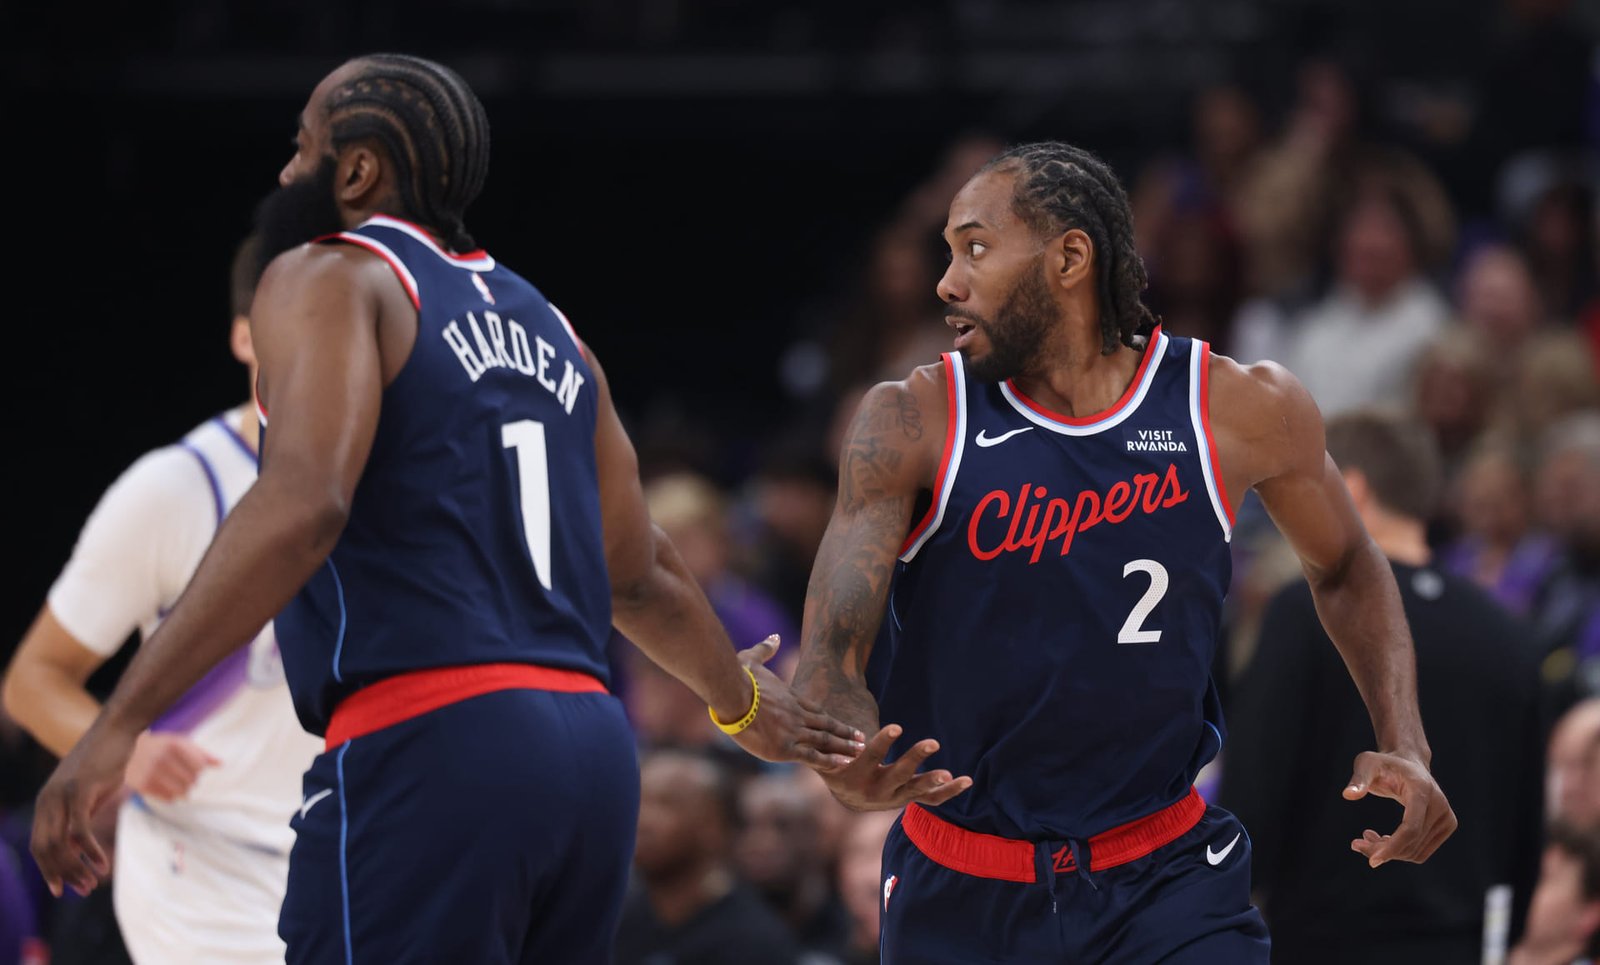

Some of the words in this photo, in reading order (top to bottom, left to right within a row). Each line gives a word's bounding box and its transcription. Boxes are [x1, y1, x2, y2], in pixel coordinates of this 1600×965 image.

[442, 310, 585, 415] HARDEN
[1126, 440, 1187, 452] RWANDA
[1137, 429, 1173, 441] VISIT
[501, 419, 552, 591] 1
[966, 463, 1189, 564] Clippers
[1117, 558, 1169, 644] 2
